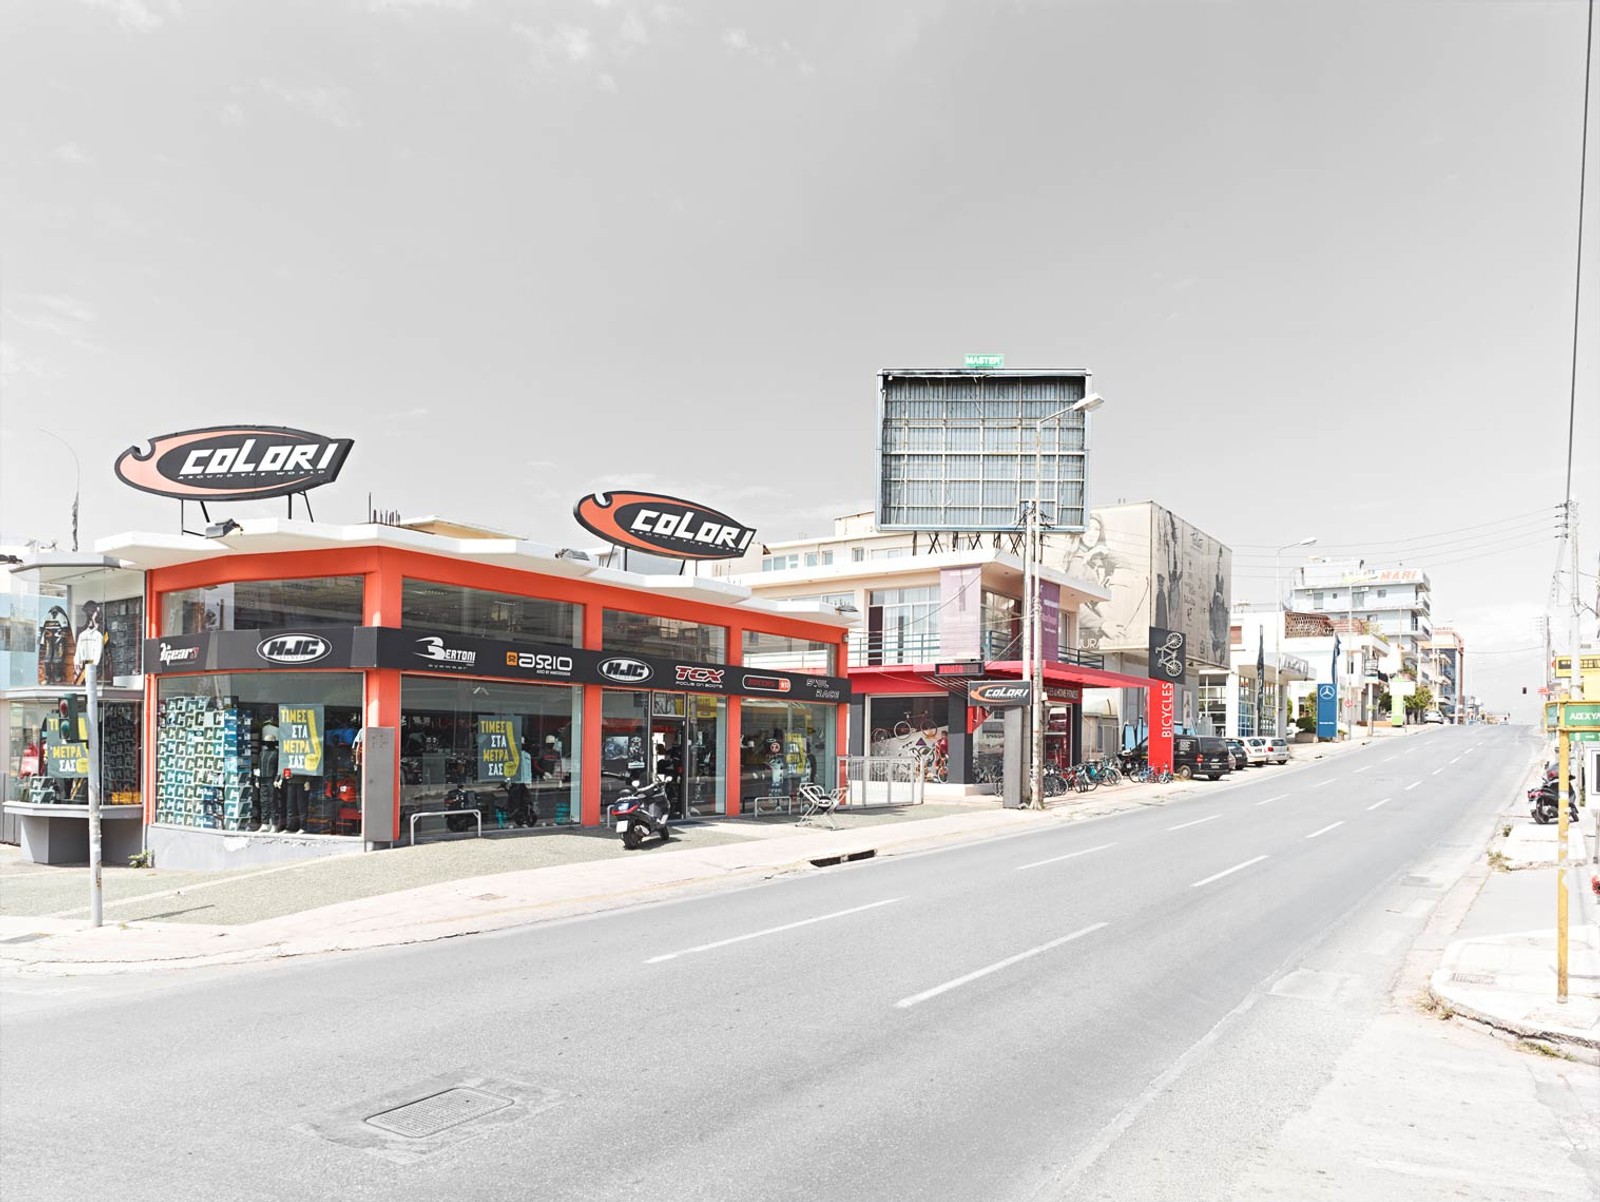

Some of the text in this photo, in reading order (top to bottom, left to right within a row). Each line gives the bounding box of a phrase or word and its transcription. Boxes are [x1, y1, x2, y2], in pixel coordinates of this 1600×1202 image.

[966, 356, 1000, 364] MASTER
[178, 439, 338, 475] COLORI
[630, 509, 754, 550] COLORI
[267, 640, 320, 656] HJC
[606, 662, 646, 677] HJC
[675, 666, 724, 683] TCX
[984, 687, 1029, 697] COLORI
[280, 708, 307, 723] ΤΙΜΕΣ
[1162, 682, 1173, 738] BICYCLES
[292, 725, 308, 738] ΣΤΑ
[480, 720, 506, 733] ΤΙΜΕΣ
[283, 740, 310, 753] ΜΕΤΡΑ
[491, 735, 507, 747] ΣΤΑ
[52, 746, 81, 758] ΜΕΤΡΑ
[483, 749, 509, 762] ΜΕΤΡΑ
[59, 760, 76, 772] ΣΑΣ
[288, 755, 305, 768] ΣΑΣ
[488, 763, 503, 776] ΣΑΣ
